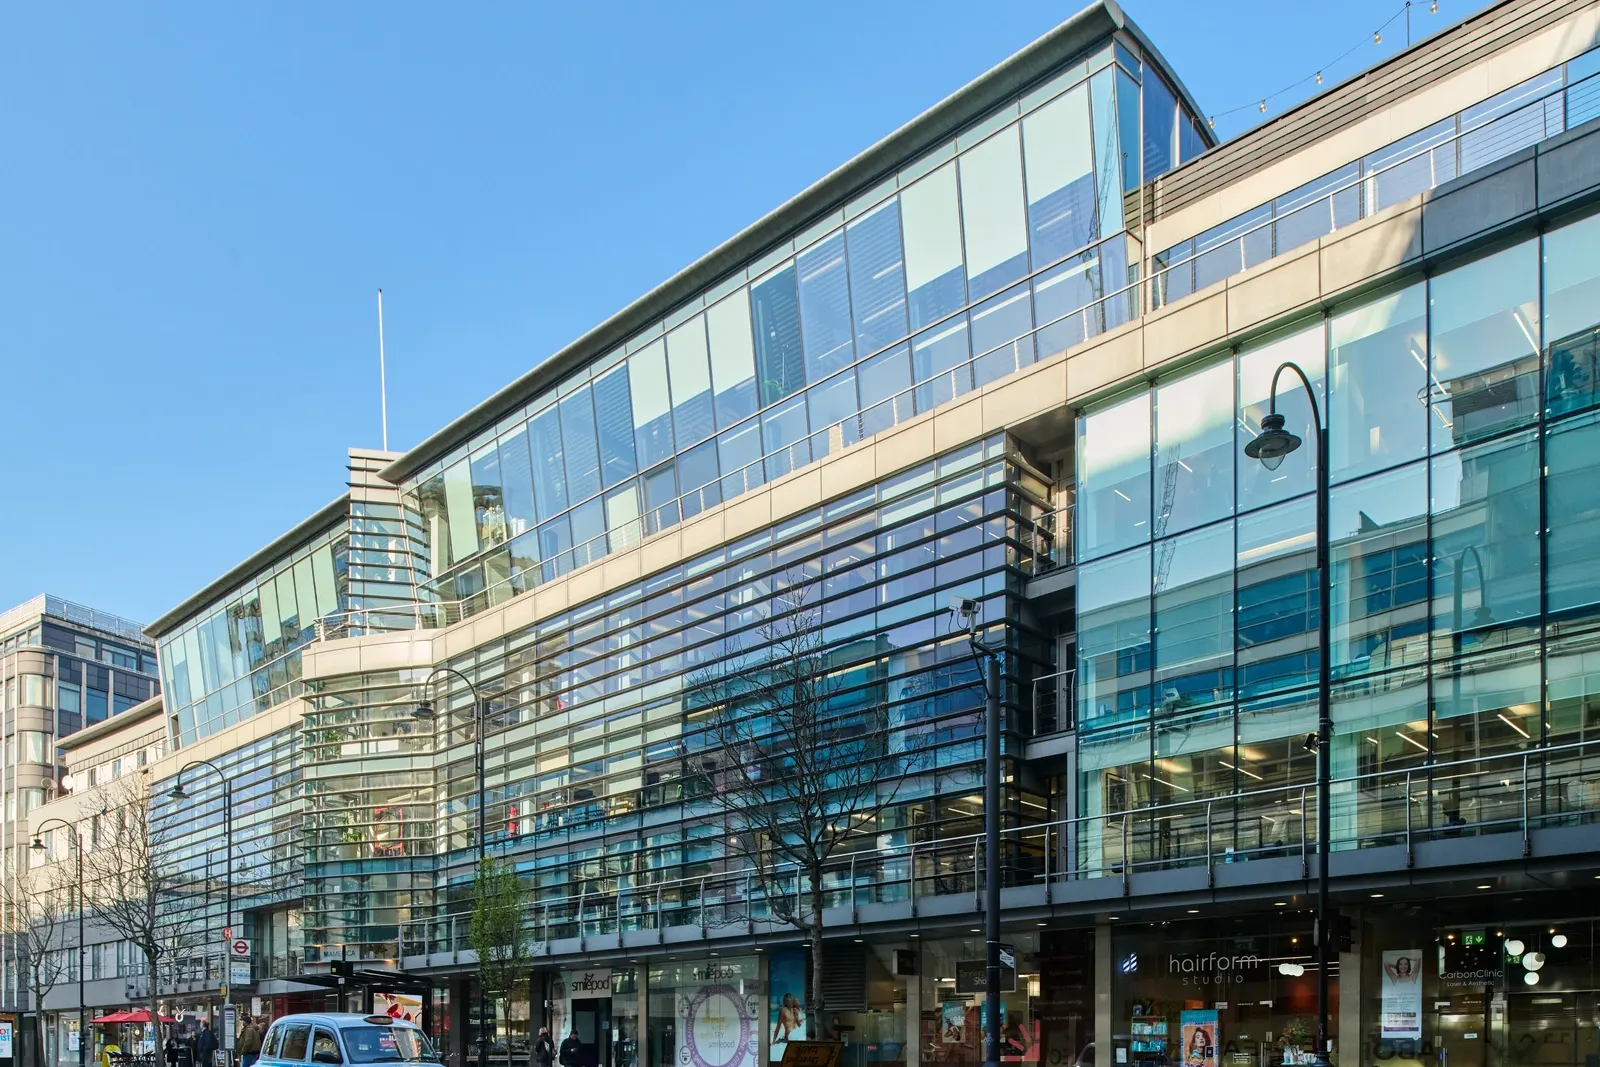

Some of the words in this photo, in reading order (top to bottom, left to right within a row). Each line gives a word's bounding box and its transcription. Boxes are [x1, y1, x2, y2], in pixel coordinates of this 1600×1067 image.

[1169, 952, 1258, 973] hairform
[1182, 973, 1244, 985] studio
[1439, 969, 1504, 979] CarbonClinic
[572, 974, 610, 995] smilepod
[973, 977, 987, 985] Sho
